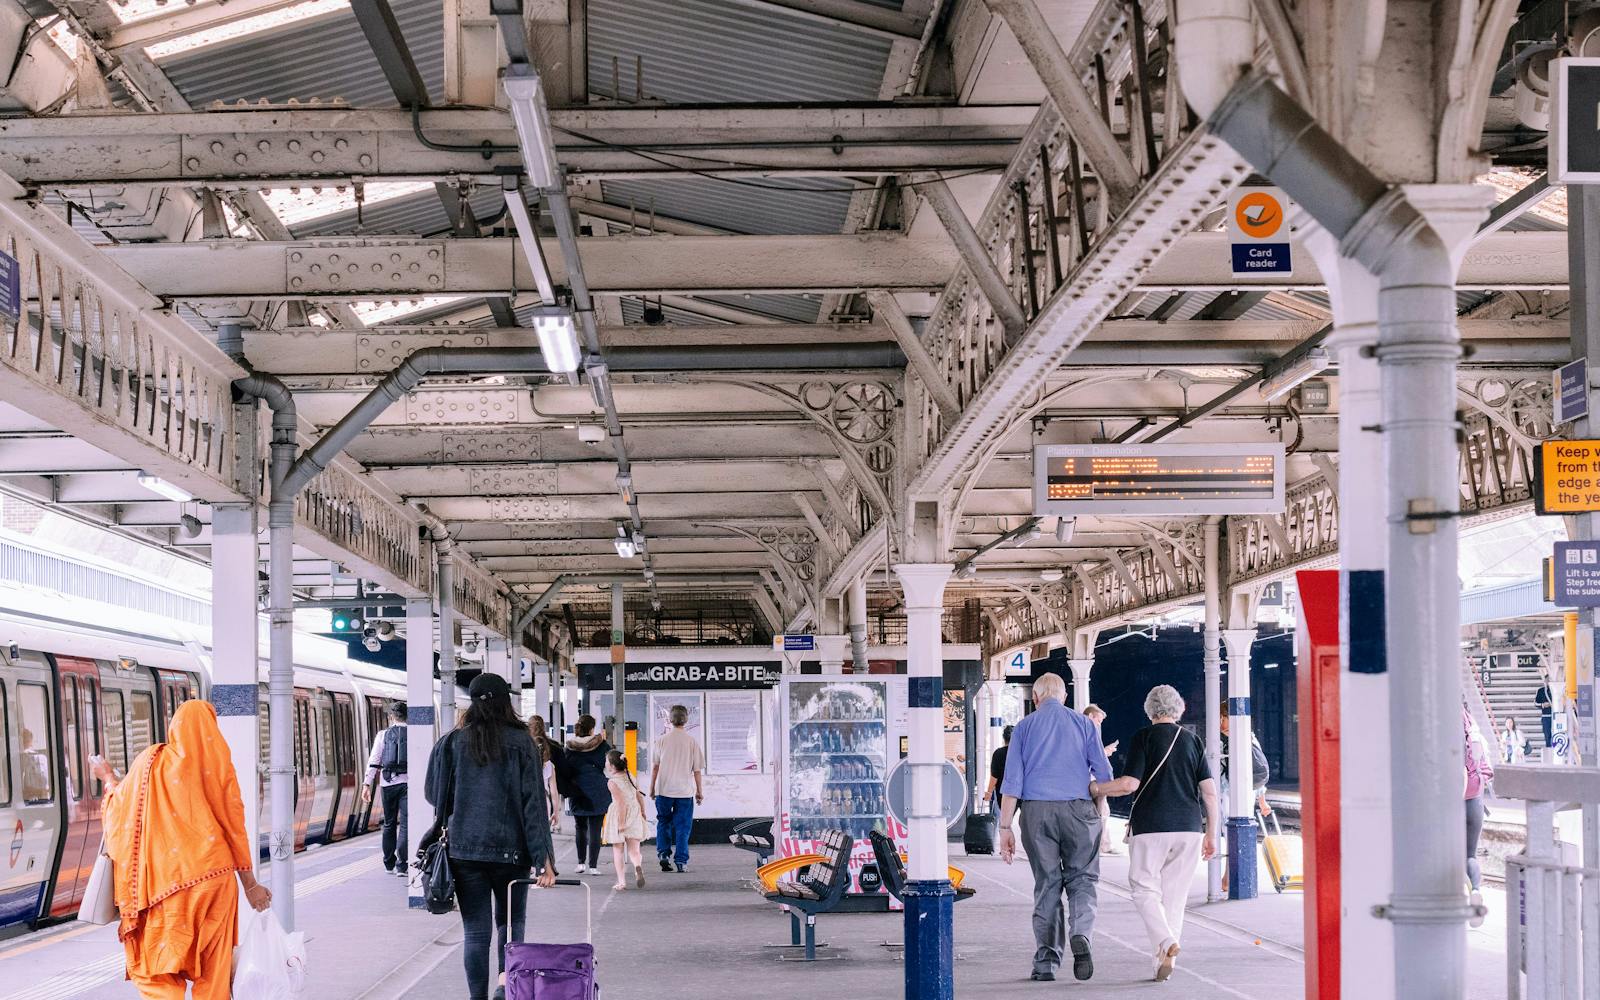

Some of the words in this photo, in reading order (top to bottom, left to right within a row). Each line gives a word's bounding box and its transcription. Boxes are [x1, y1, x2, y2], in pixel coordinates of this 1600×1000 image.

[1249, 248, 1272, 257] Card
[1245, 259, 1277, 268] reader
[1047, 446, 1084, 455] Platform
[1092, 446, 1142, 455] Destination
[1556, 446, 1590, 459] Keep
[1557, 461, 1588, 473] from
[1557, 477, 1591, 490] edge
[1558, 492, 1580, 503] the
[1566, 569, 1580, 577] Lift
[1582, 569, 1589, 577] is
[1566, 578, 1585, 587] Step
[1011, 651, 1026, 671] 4
[650, 665, 764, 682] GRAB-A-BITE
[800, 874, 815, 883] PUSH
[862, 873, 878, 882] PUSH
